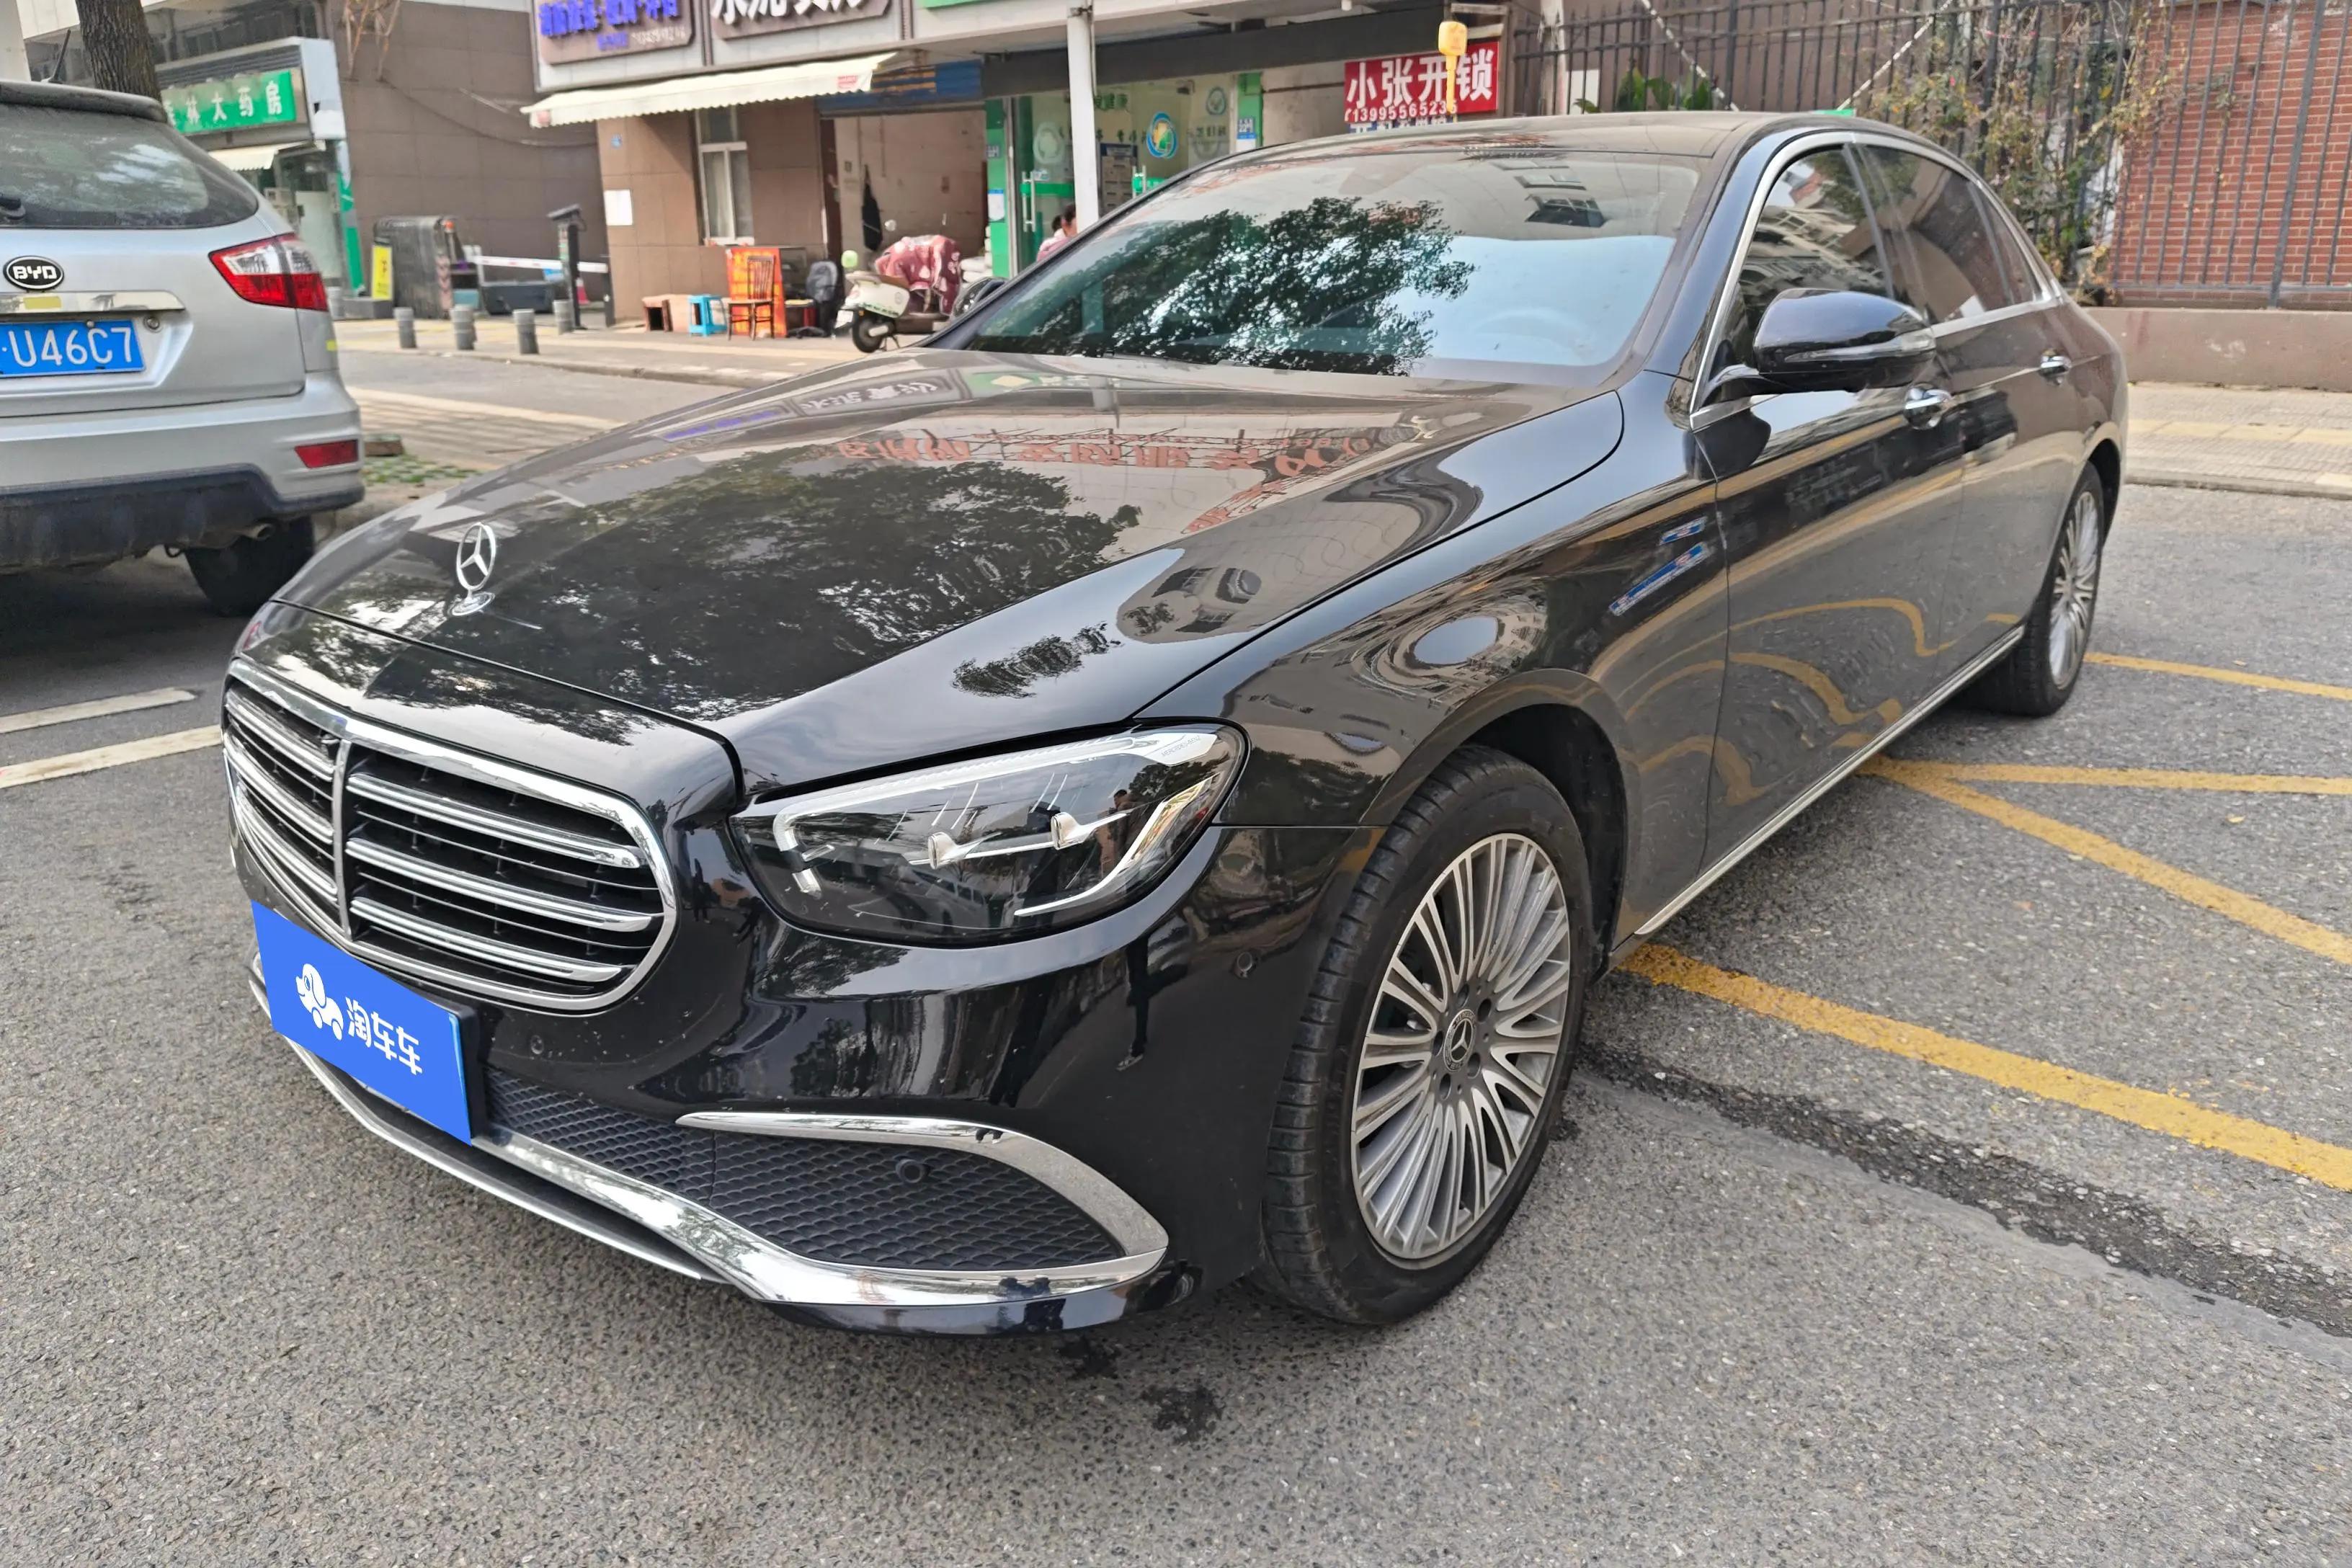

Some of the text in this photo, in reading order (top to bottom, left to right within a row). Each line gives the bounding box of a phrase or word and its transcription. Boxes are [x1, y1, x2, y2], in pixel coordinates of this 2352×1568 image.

[1346, 48, 1494, 109] 小张开锁
[12, 265, 58, 280] BYD
